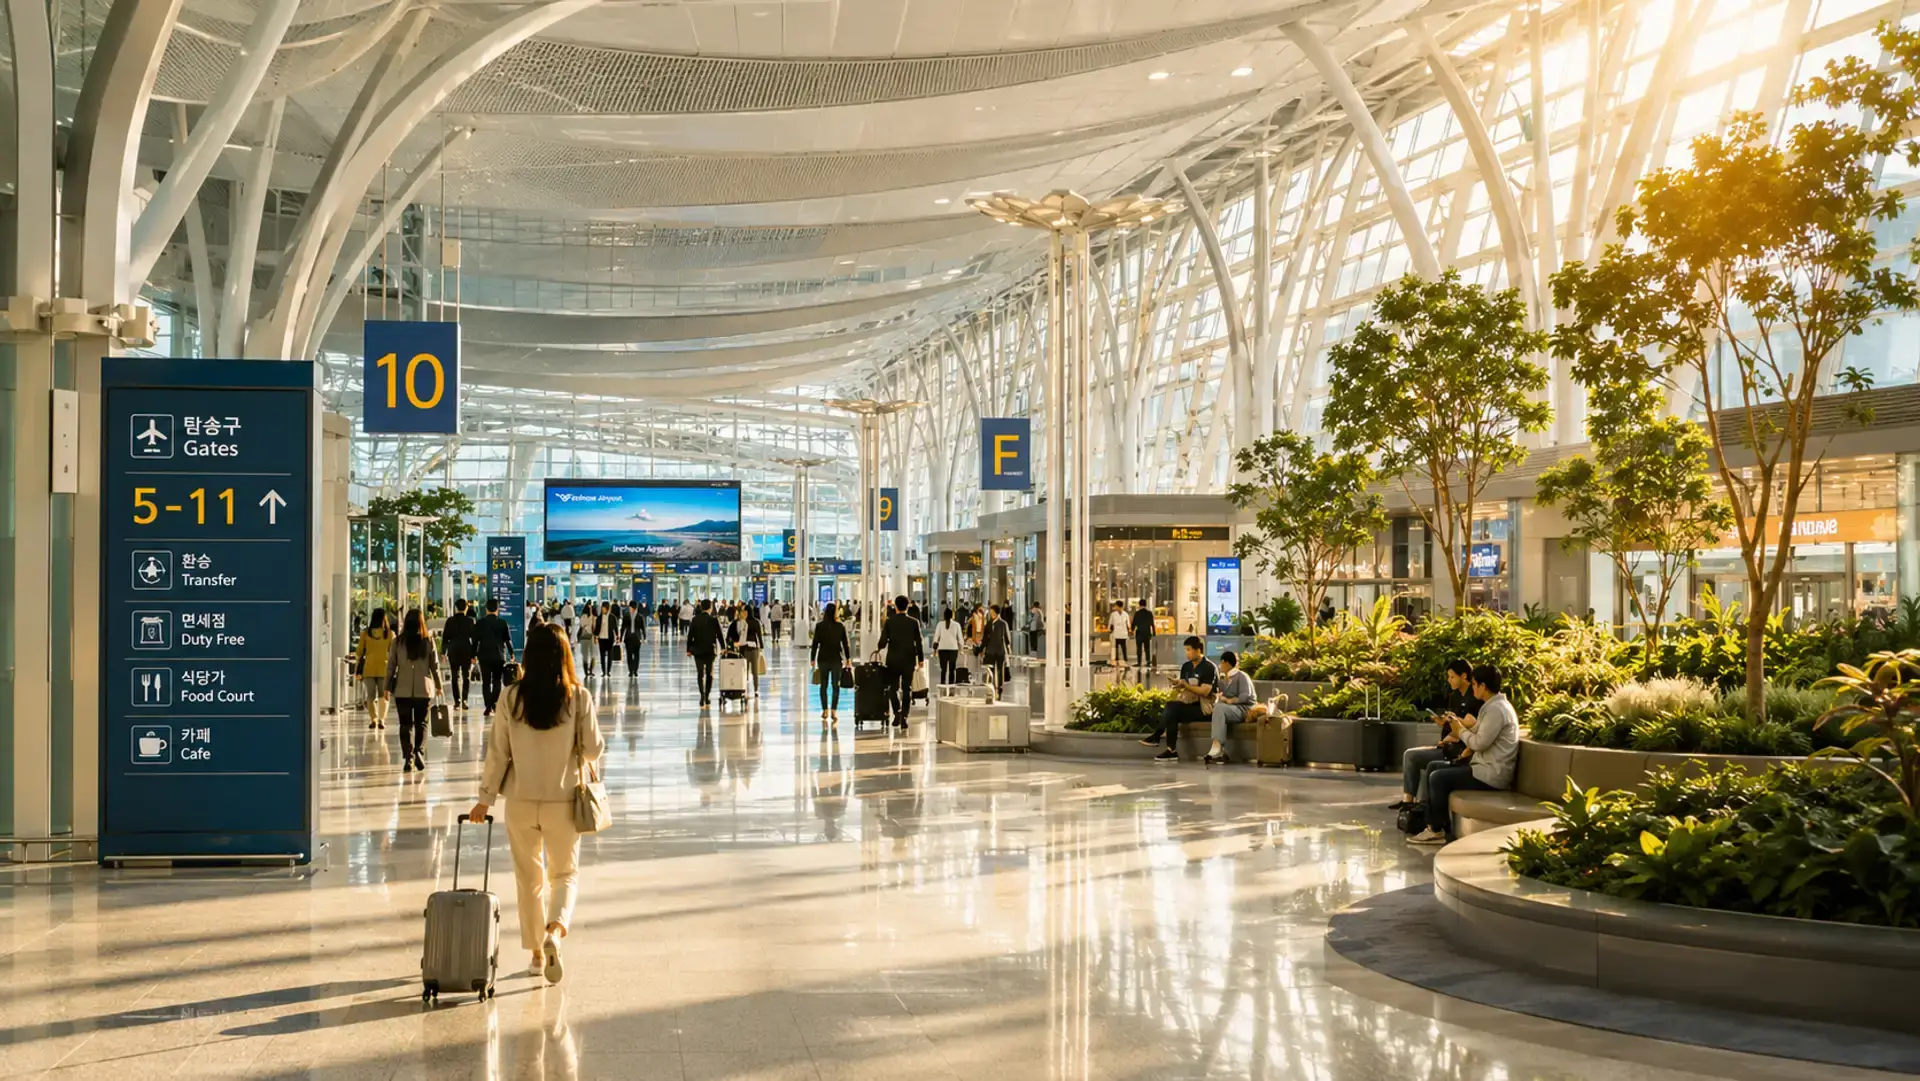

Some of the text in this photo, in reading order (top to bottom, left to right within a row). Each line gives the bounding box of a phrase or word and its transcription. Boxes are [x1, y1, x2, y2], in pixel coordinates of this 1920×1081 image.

[376, 353, 445, 409] 10
[183, 440, 239, 457] Gates
[994, 434, 1020, 476] F
[133, 487, 235, 525] 5-11
[880, 496, 893, 522] 9
[181, 553, 212, 569] 환승
[181, 573, 237, 586] Transfer
[181, 613, 226, 629] 면세점
[181, 633, 245, 648] Duty Free
[181, 670, 226, 686] 식당가
[181, 690, 255, 702] Food Court
[181, 727, 211, 743] 카페
[181, 747, 211, 760] Cafe
